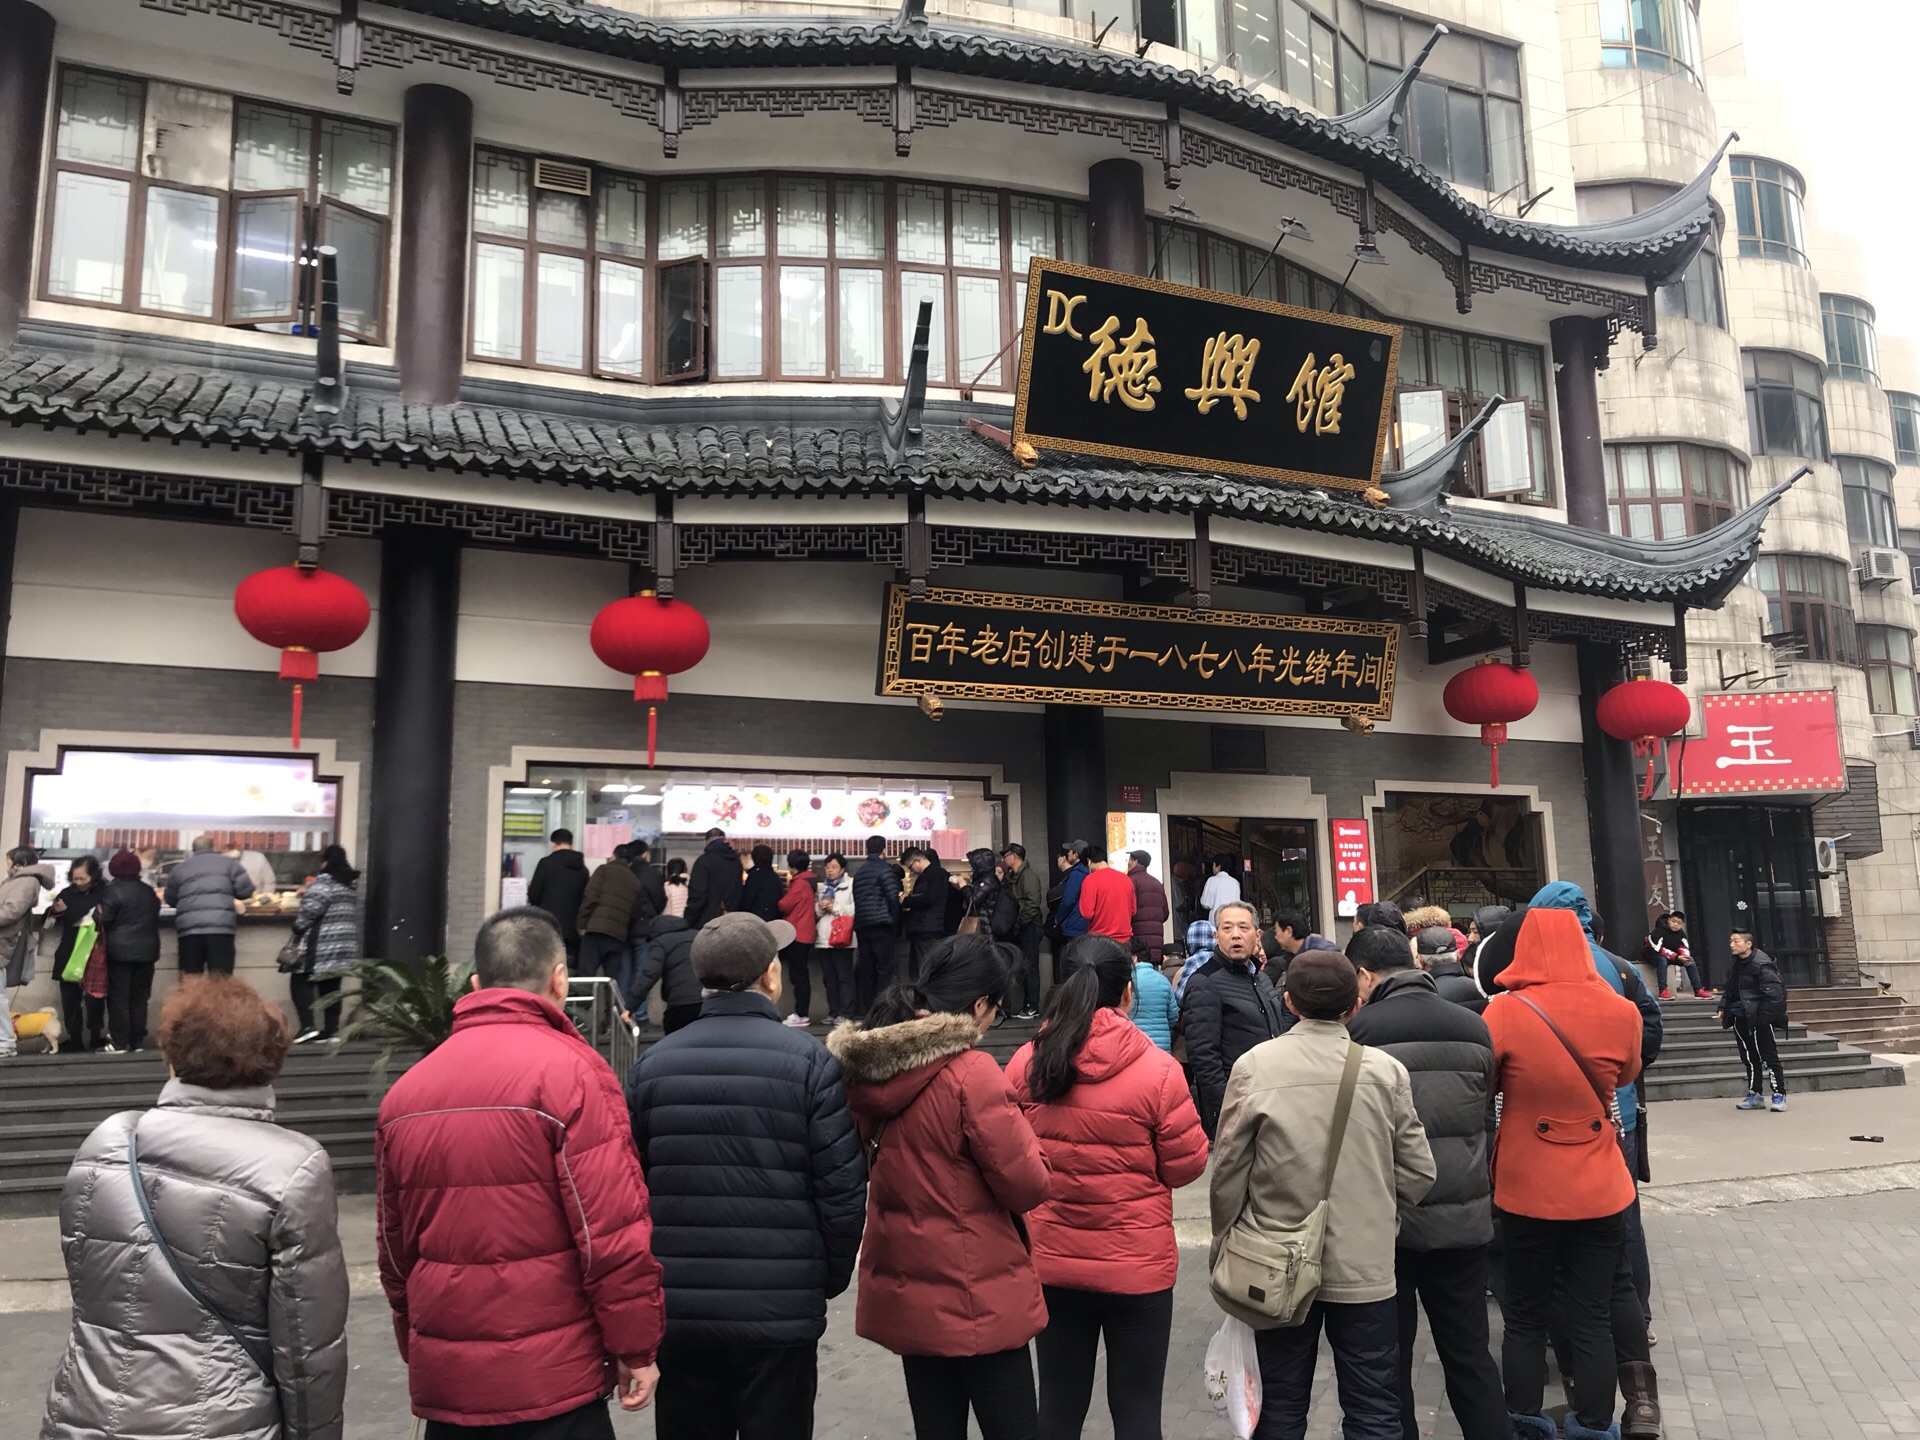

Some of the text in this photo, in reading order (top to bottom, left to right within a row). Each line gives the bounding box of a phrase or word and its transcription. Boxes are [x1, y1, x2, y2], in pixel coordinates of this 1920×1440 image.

[906, 621, 1382, 691] 百年老店创建于一八七八年光绪年间
[1716, 725, 1792, 769] 玉
